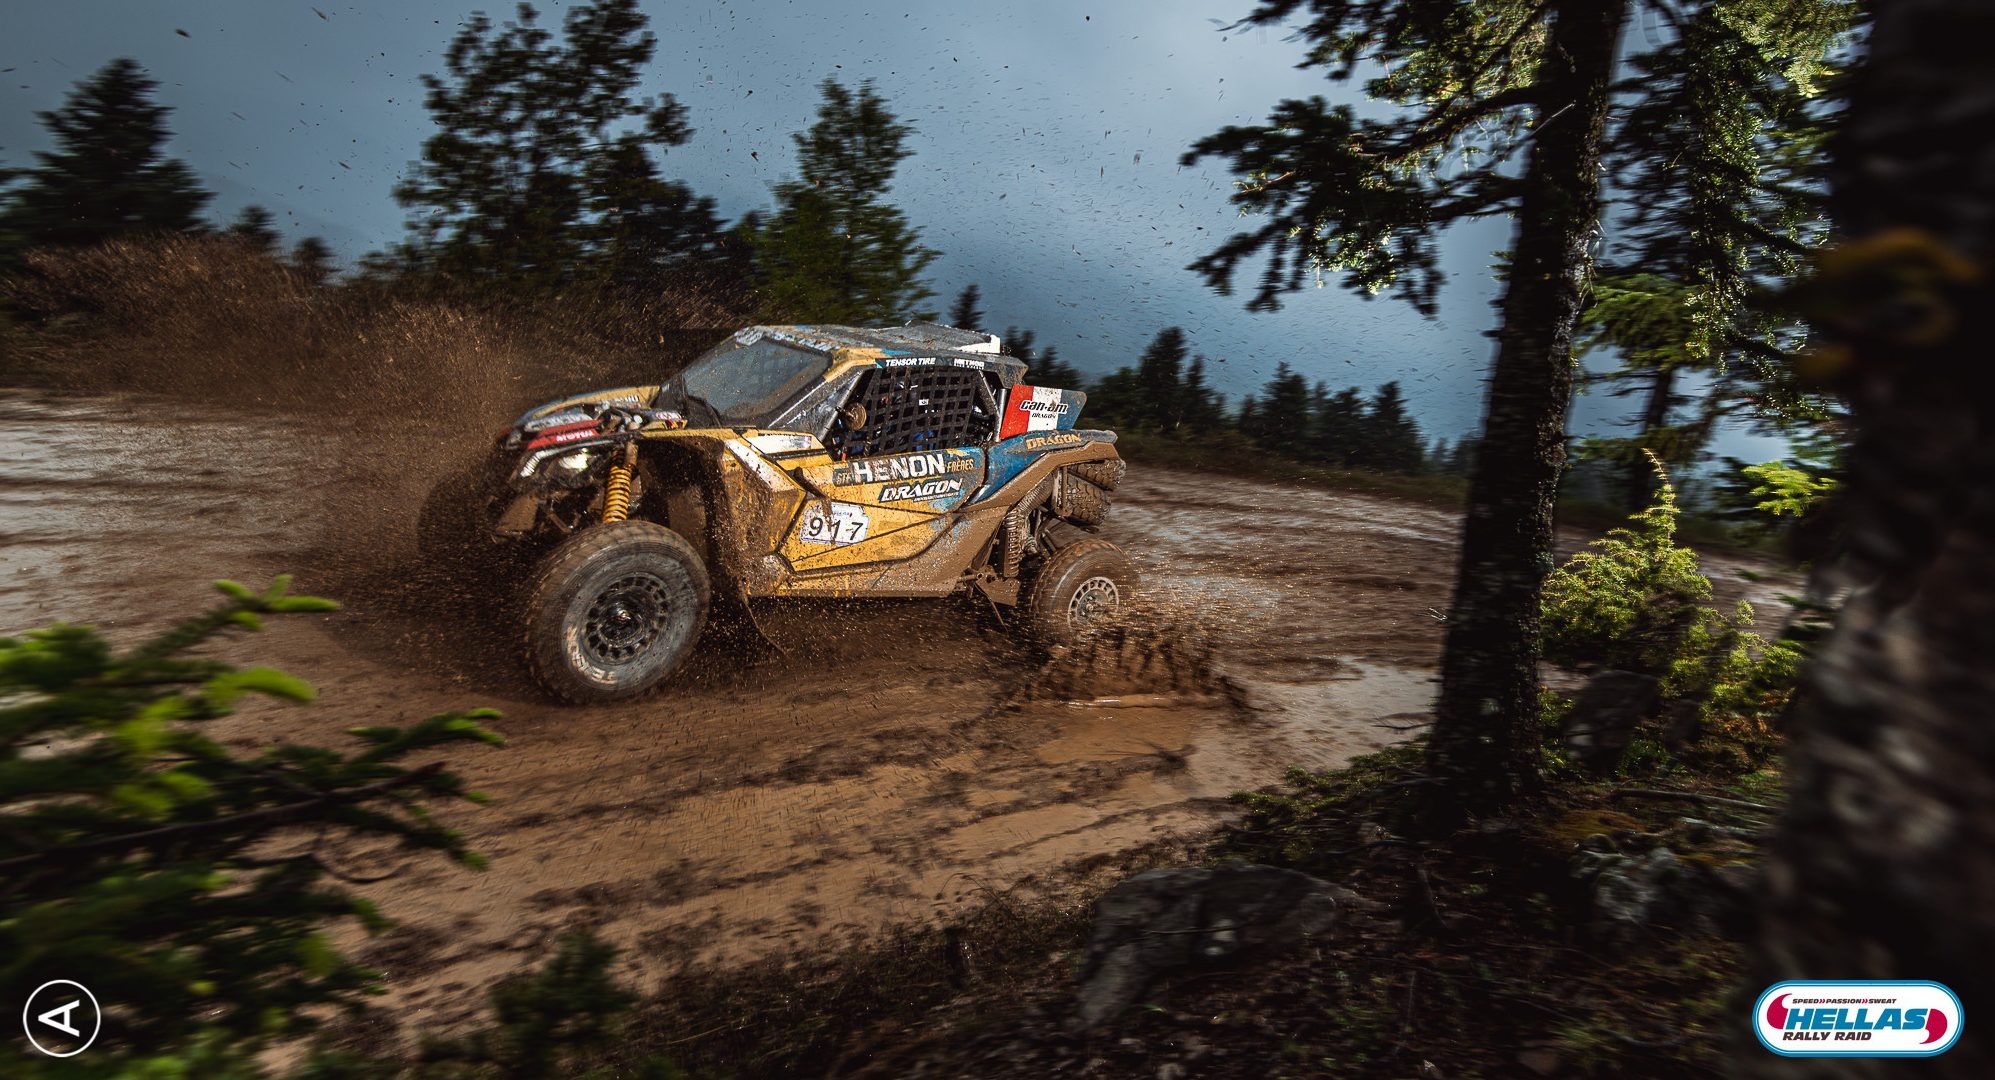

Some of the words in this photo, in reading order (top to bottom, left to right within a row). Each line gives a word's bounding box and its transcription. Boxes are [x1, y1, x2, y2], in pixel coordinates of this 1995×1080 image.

[885, 358, 917, 367] TENSOR
[918, 357, 936, 365] TIRE
[1026, 434, 1081, 449] DRAGON
[852, 453, 946, 483] HENON
[881, 478, 963, 501] DRAGON
[808, 517, 863, 541] 917
